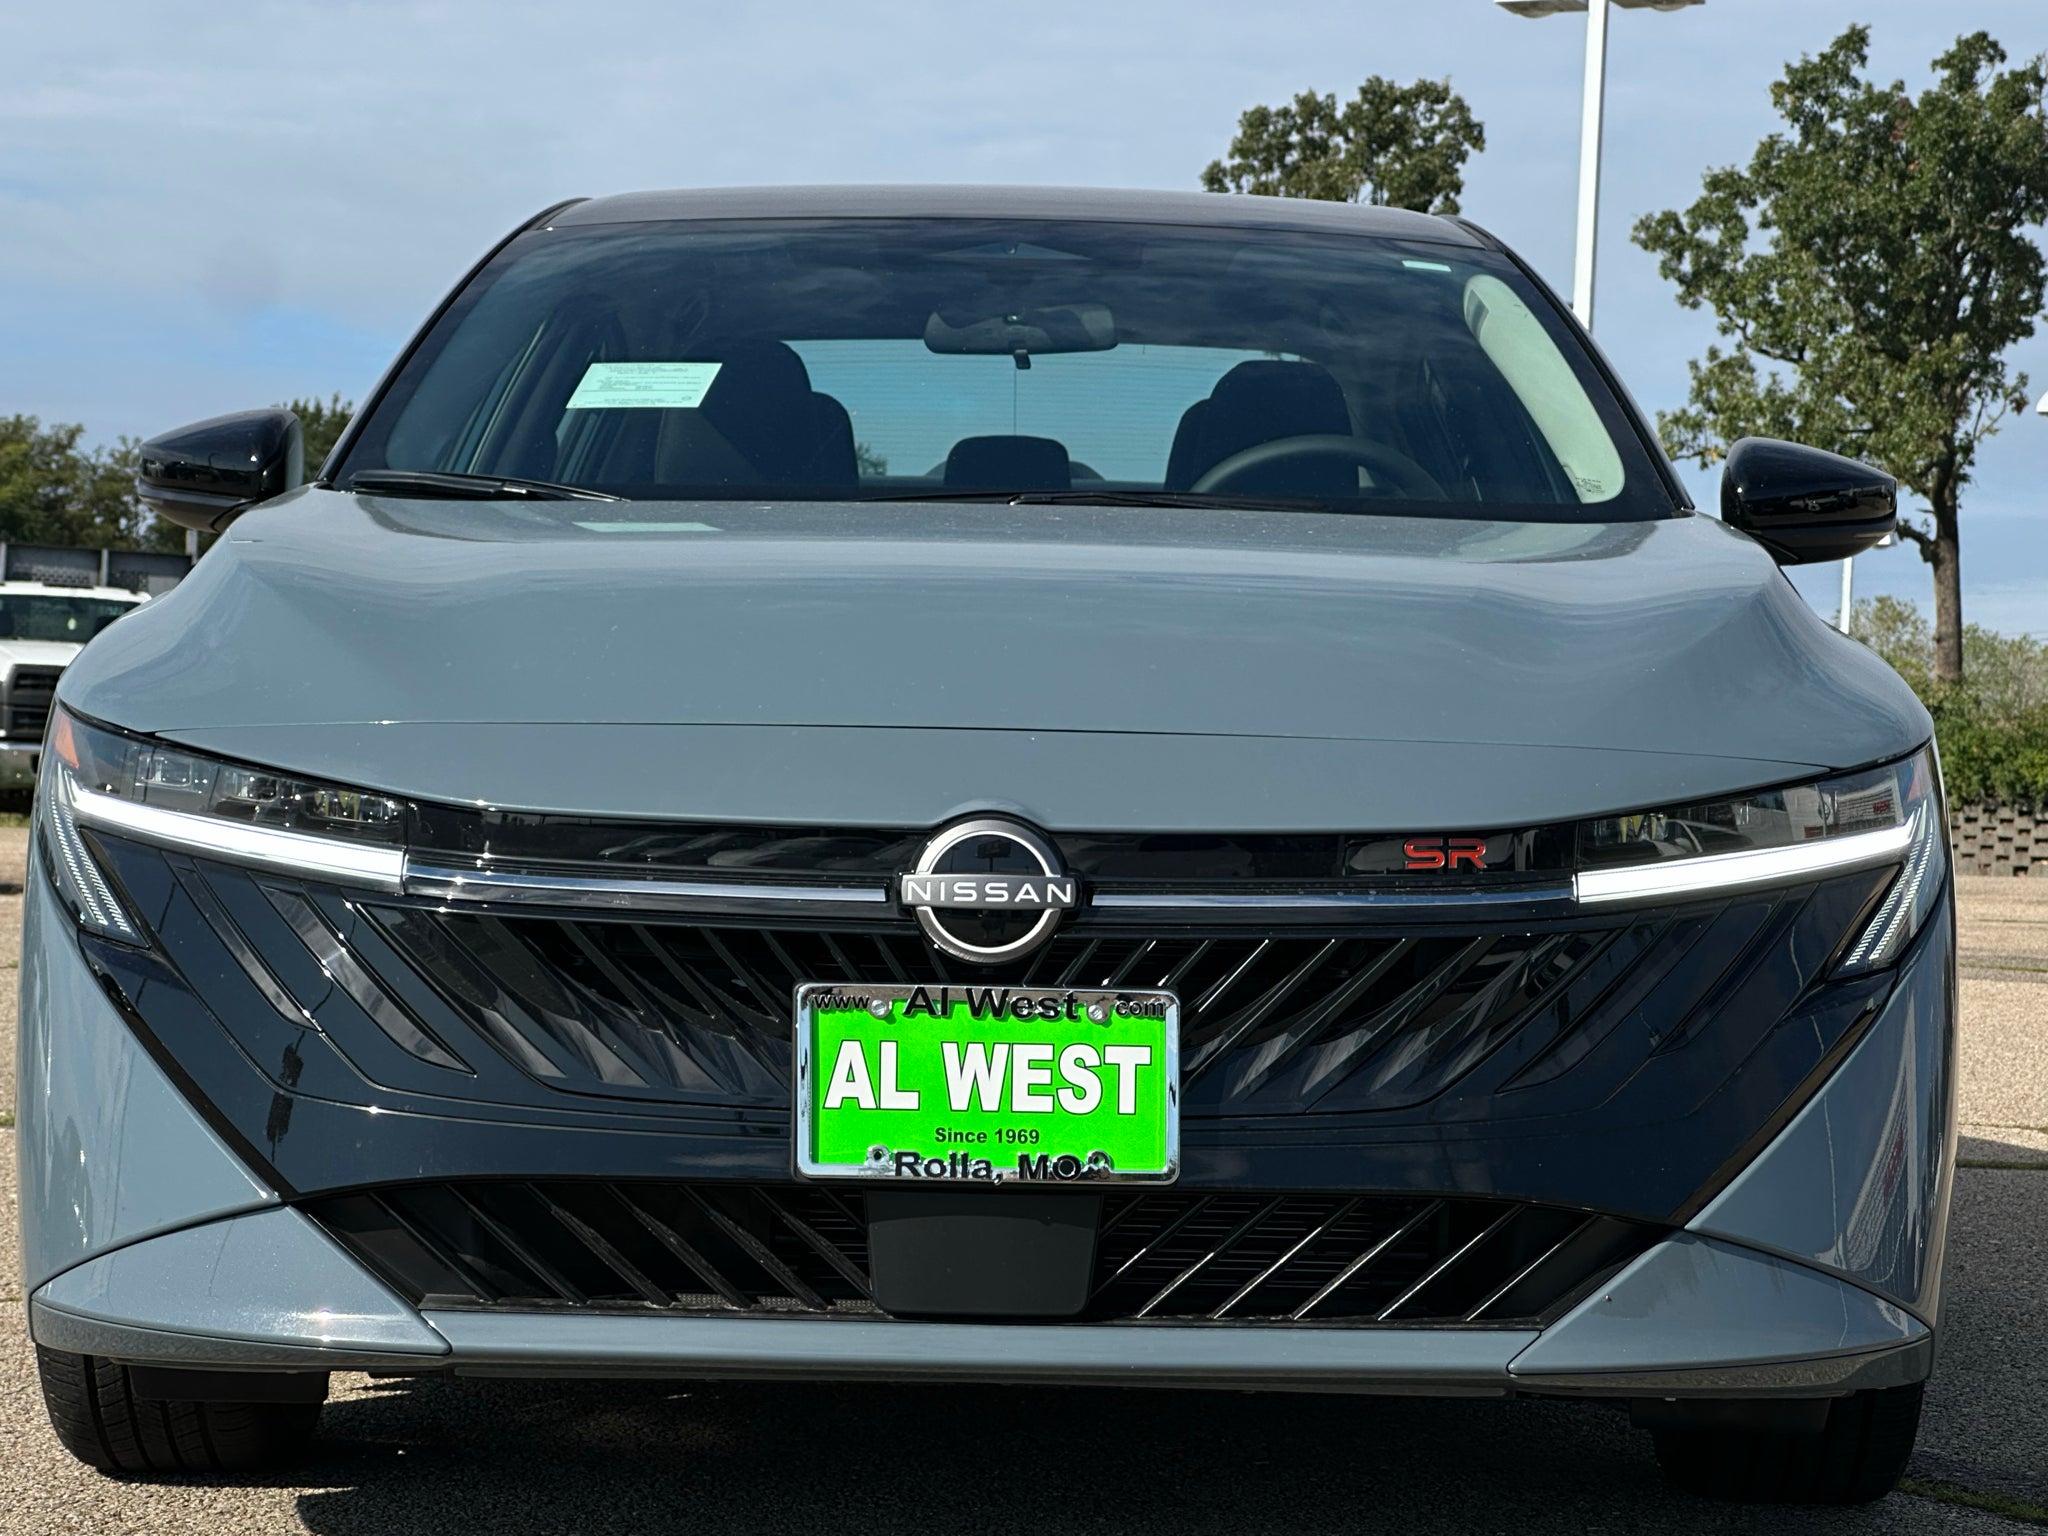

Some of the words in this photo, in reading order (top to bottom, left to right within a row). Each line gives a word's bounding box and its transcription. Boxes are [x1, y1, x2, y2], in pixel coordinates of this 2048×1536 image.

[1404, 838, 1487, 869] SR
[907, 881, 1071, 903] NISSAN
[903, 986, 948, 1017] Al
[965, 987, 1078, 1021] West
[823, 1040, 920, 1110] AL
[941, 1042, 1152, 1115] WEST
[935, 1127, 987, 1144] Since
[994, 1128, 1040, 1144] 1969
[894, 1151, 1003, 1184] Rolla,
[1018, 1153, 1081, 1181] MO
